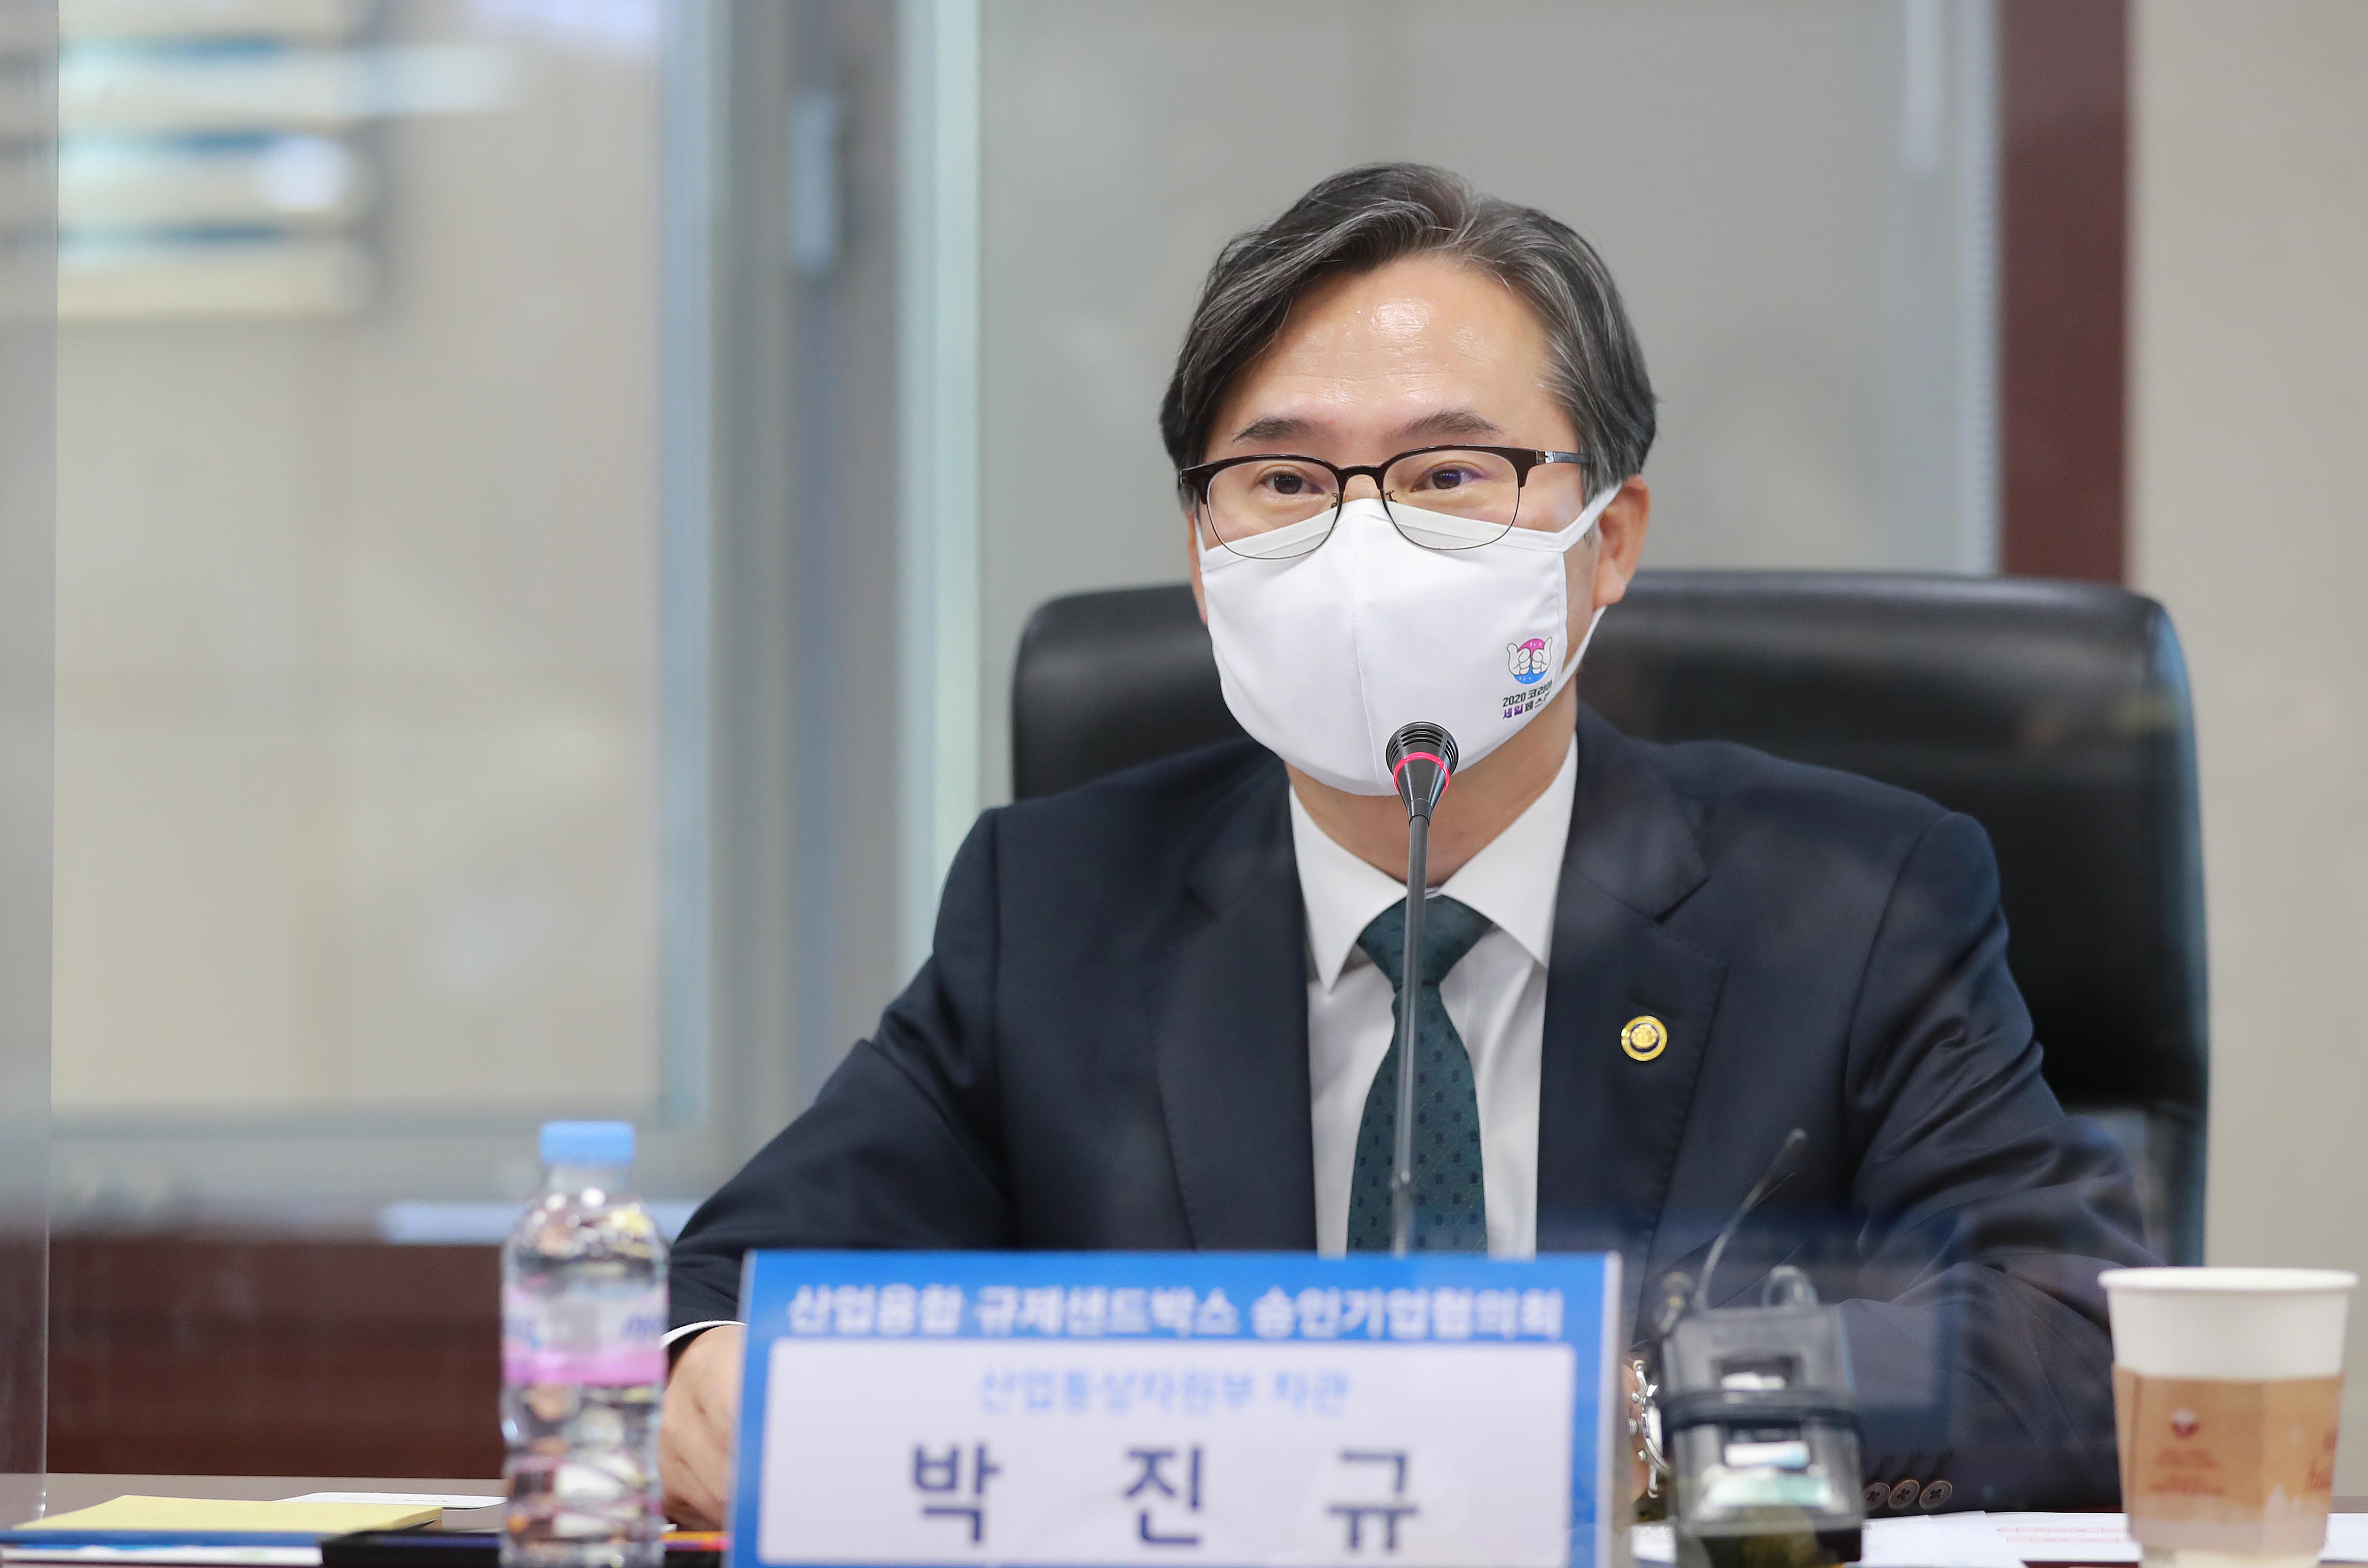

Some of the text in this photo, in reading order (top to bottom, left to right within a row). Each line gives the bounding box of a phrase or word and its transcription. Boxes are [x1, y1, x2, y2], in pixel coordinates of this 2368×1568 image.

[1502, 678, 1553, 707] 2020 코리아
[789, 1283, 966, 1335] 산업융합
[1251, 1285, 1564, 1339] 승인기업협의회
[980, 1367, 1350, 1417] 산업통상자원부 차관
[911, 1443, 1419, 1553] 박 진 규
